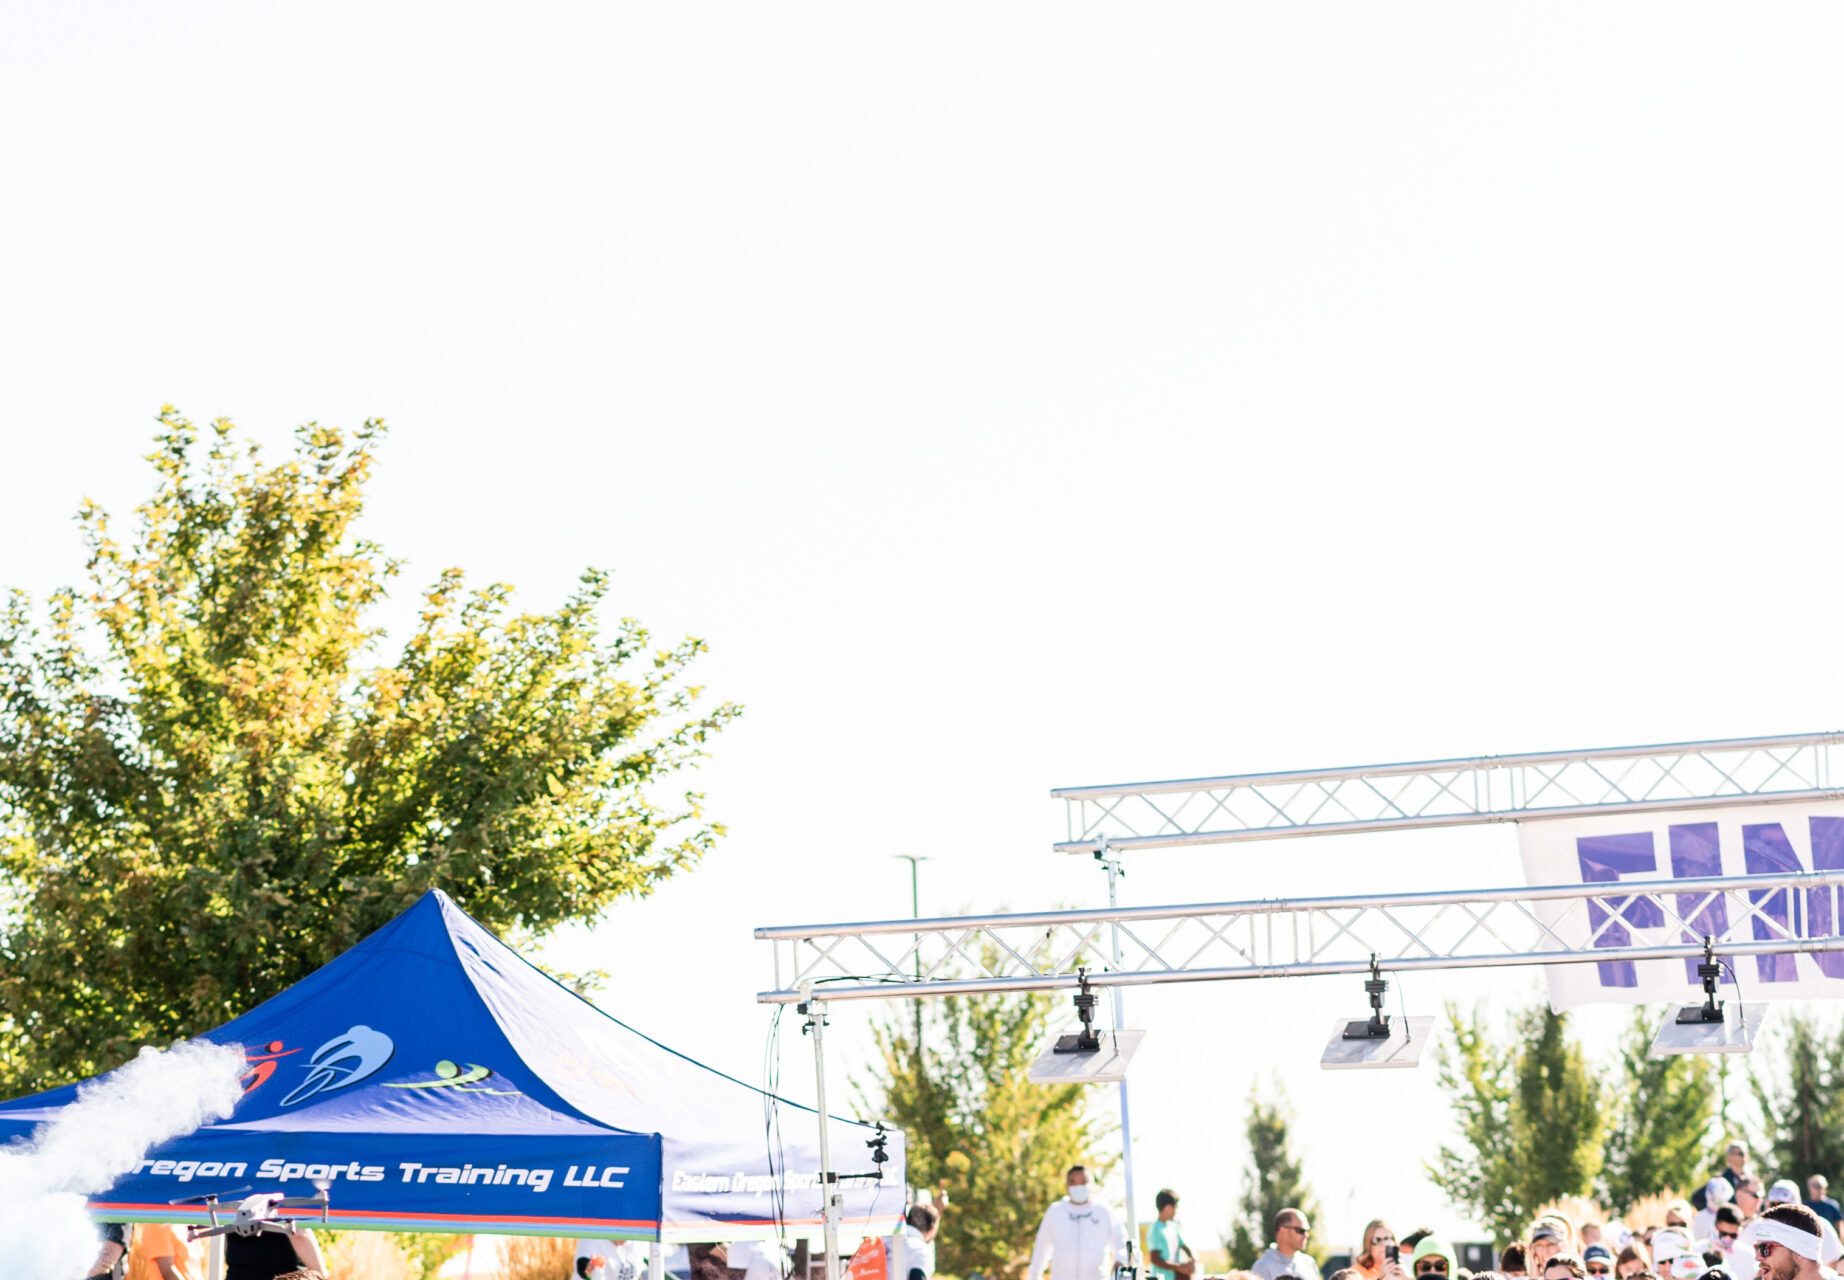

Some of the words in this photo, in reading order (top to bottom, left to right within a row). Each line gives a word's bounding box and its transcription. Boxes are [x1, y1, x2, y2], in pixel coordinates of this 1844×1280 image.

[131, 1159, 248, 1182] regon
[255, 1158, 385, 1182] Sports
[399, 1162, 554, 1192] Training
[562, 1165, 630, 1188] LLC
